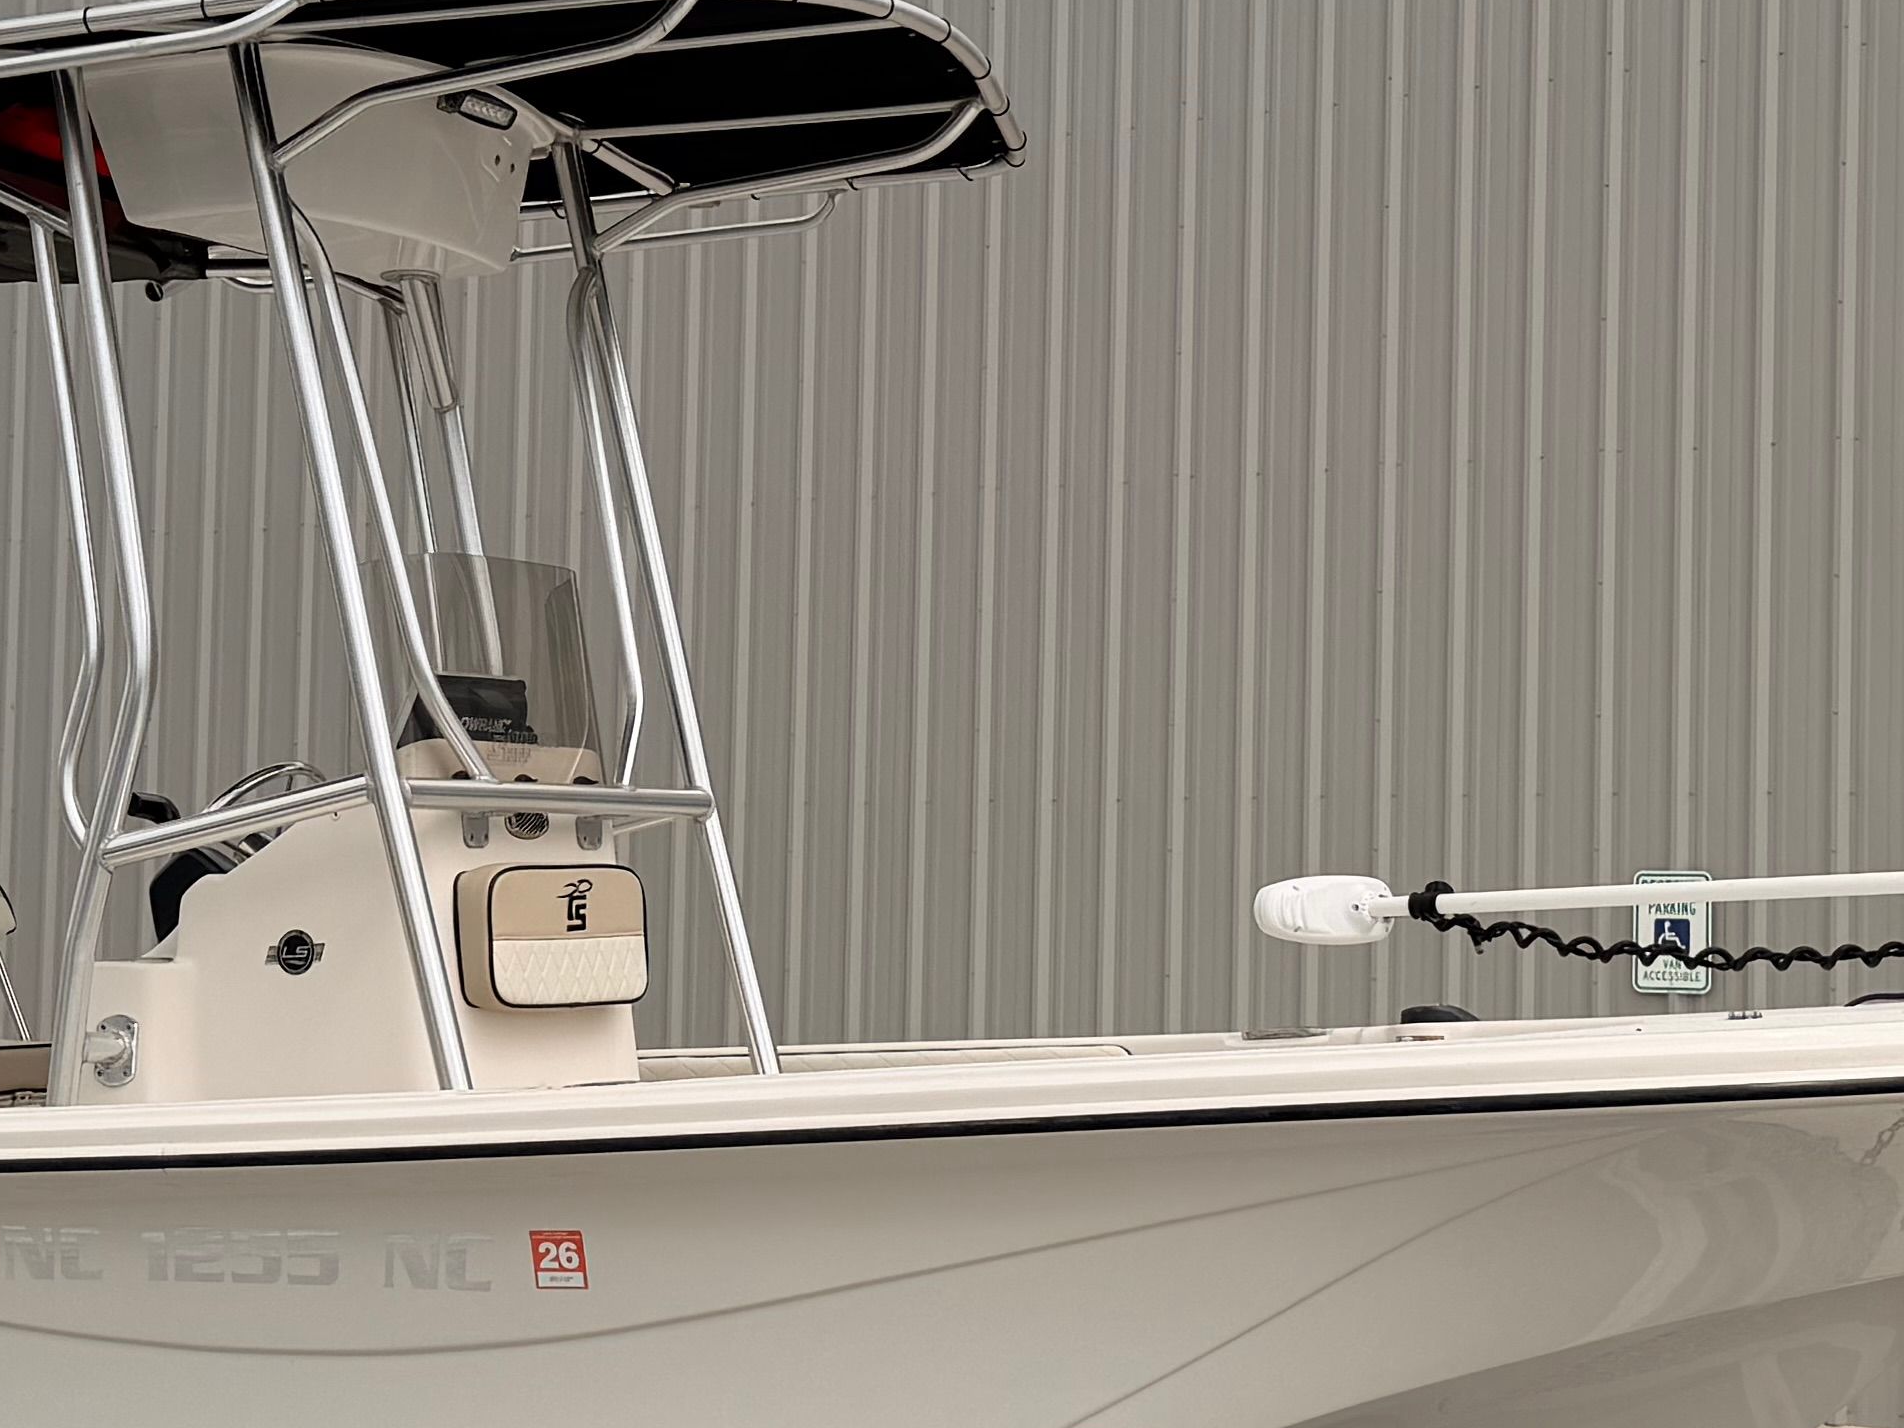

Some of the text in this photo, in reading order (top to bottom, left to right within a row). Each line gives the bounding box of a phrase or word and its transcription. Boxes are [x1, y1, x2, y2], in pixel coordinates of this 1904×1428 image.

[1643, 970, 1701, 982] ACCESSIBLE
[1, 1224, 104, 1280] NC
[384, 1233, 493, 1292] NC
[538, 1241, 580, 1269] 26
